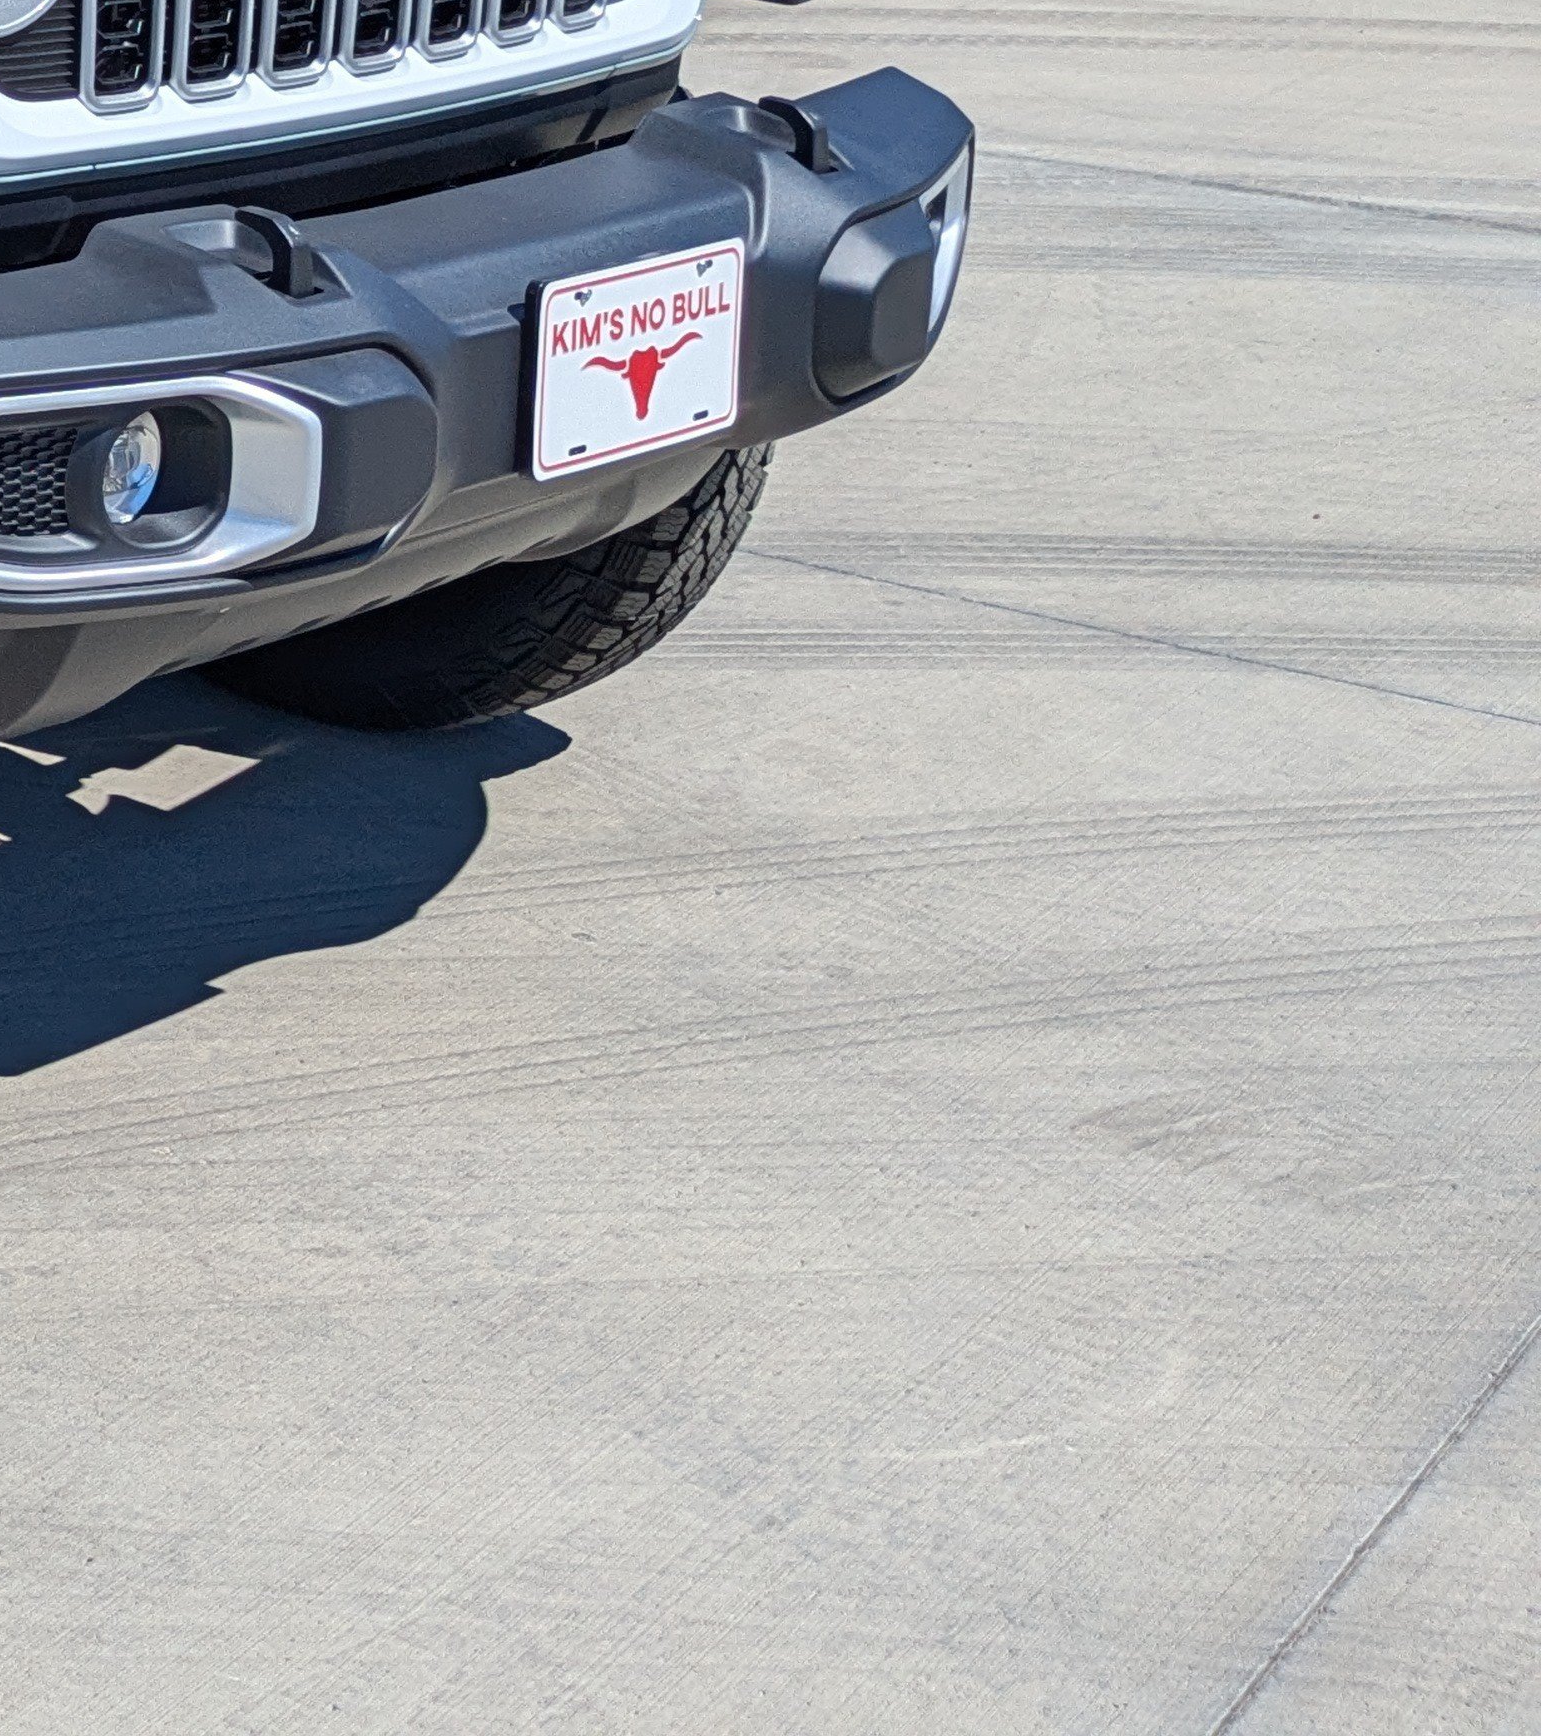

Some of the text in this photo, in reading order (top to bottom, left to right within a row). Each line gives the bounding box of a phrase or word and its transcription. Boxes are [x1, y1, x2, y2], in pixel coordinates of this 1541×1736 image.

[551, 282, 731, 357] KIM'S NO BULL
